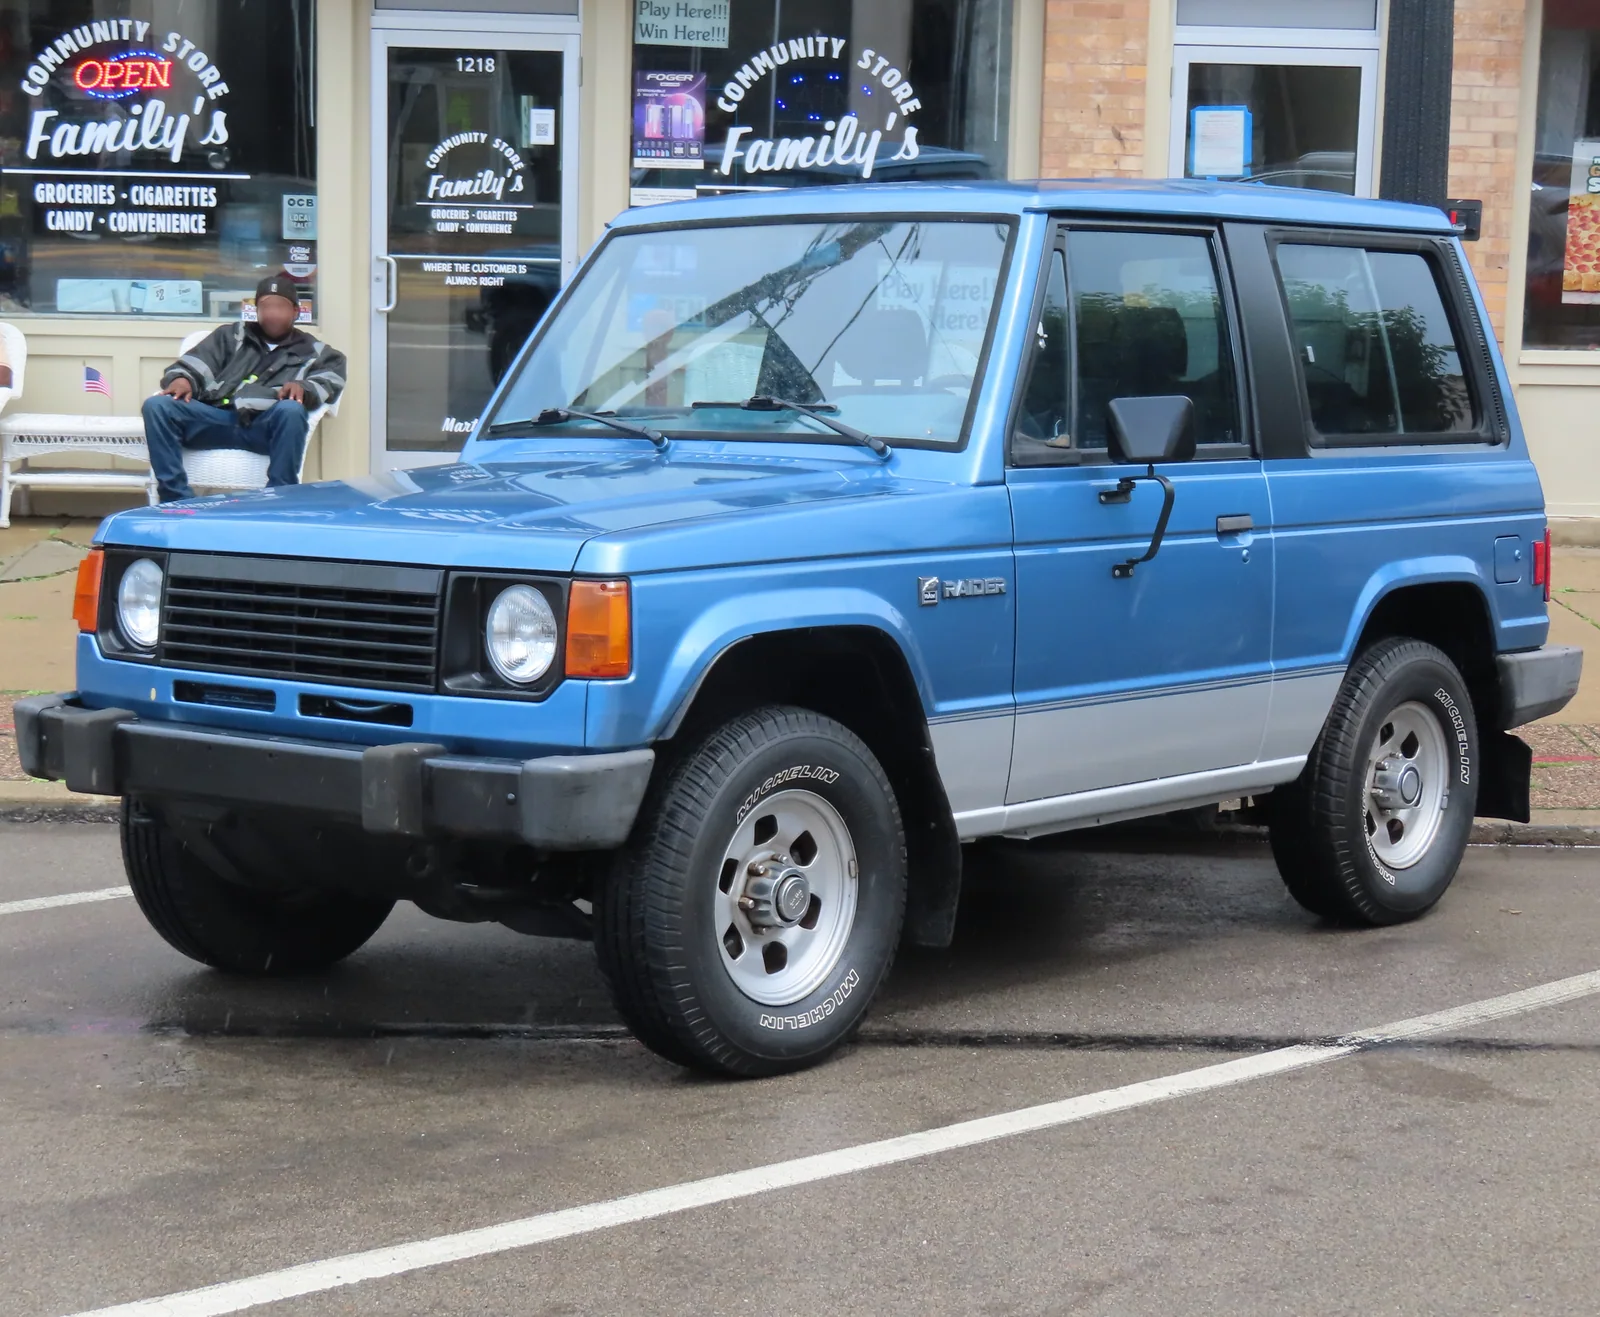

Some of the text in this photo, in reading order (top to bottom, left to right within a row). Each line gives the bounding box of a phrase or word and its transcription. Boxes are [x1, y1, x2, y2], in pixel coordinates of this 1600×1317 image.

[639, 1, 727, 20] Play Here!!!
[639, 23, 726, 42] Win Here!!!
[21, 19, 230, 101] COMMUNITY STORE
[455, 57, 496, 73] 1218
[74, 60, 173, 89] OPEN
[646, 73, 694, 82] FOGER
[717, 36, 847, 113] COMMUNITY
[857, 49, 922, 116] STORE
[26, 96, 229, 163] Family's
[425, 132, 525, 171] COMMUNITY STORE
[720, 111, 920, 179] Family's
[35, 183, 218, 208] GROCERIES CIGARETTES
[427, 168, 524, 200] Family's
[287, 198, 315, 207] OCB
[46, 210, 207, 234] CANDY CONVENIENCE
[431, 209, 518, 222] GROCERIES CIGARETTES
[436, 222, 512, 234] CANDY CONVENIENCE
[423, 262, 527, 274] WHERE THE CUSTOMER IS
[445, 275, 505, 286] ALWAYS RIGHT
[942, 577, 1006, 599] RAIDER
[1434, 687, 1471, 785] MICHELIN
[735, 764, 840, 826] MICHELIN
[760, 968, 860, 1031] MICHELIN
